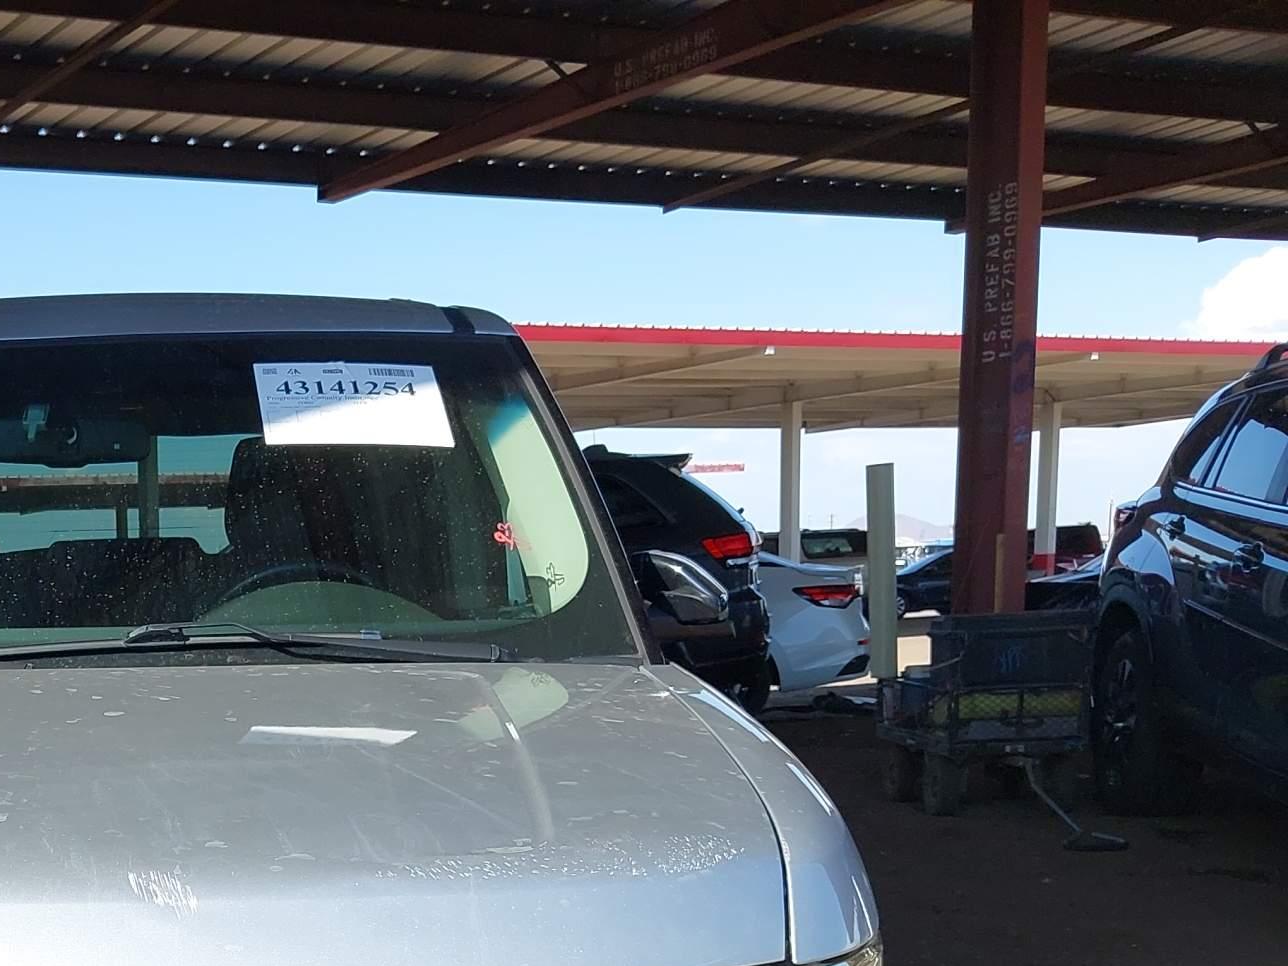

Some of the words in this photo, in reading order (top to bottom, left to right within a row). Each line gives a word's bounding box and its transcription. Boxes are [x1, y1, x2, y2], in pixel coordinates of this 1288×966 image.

[987, 183, 1002, 223] INC.
[984, 233, 1000, 313] PREFAB
[276, 379, 416, 396] 43141254
